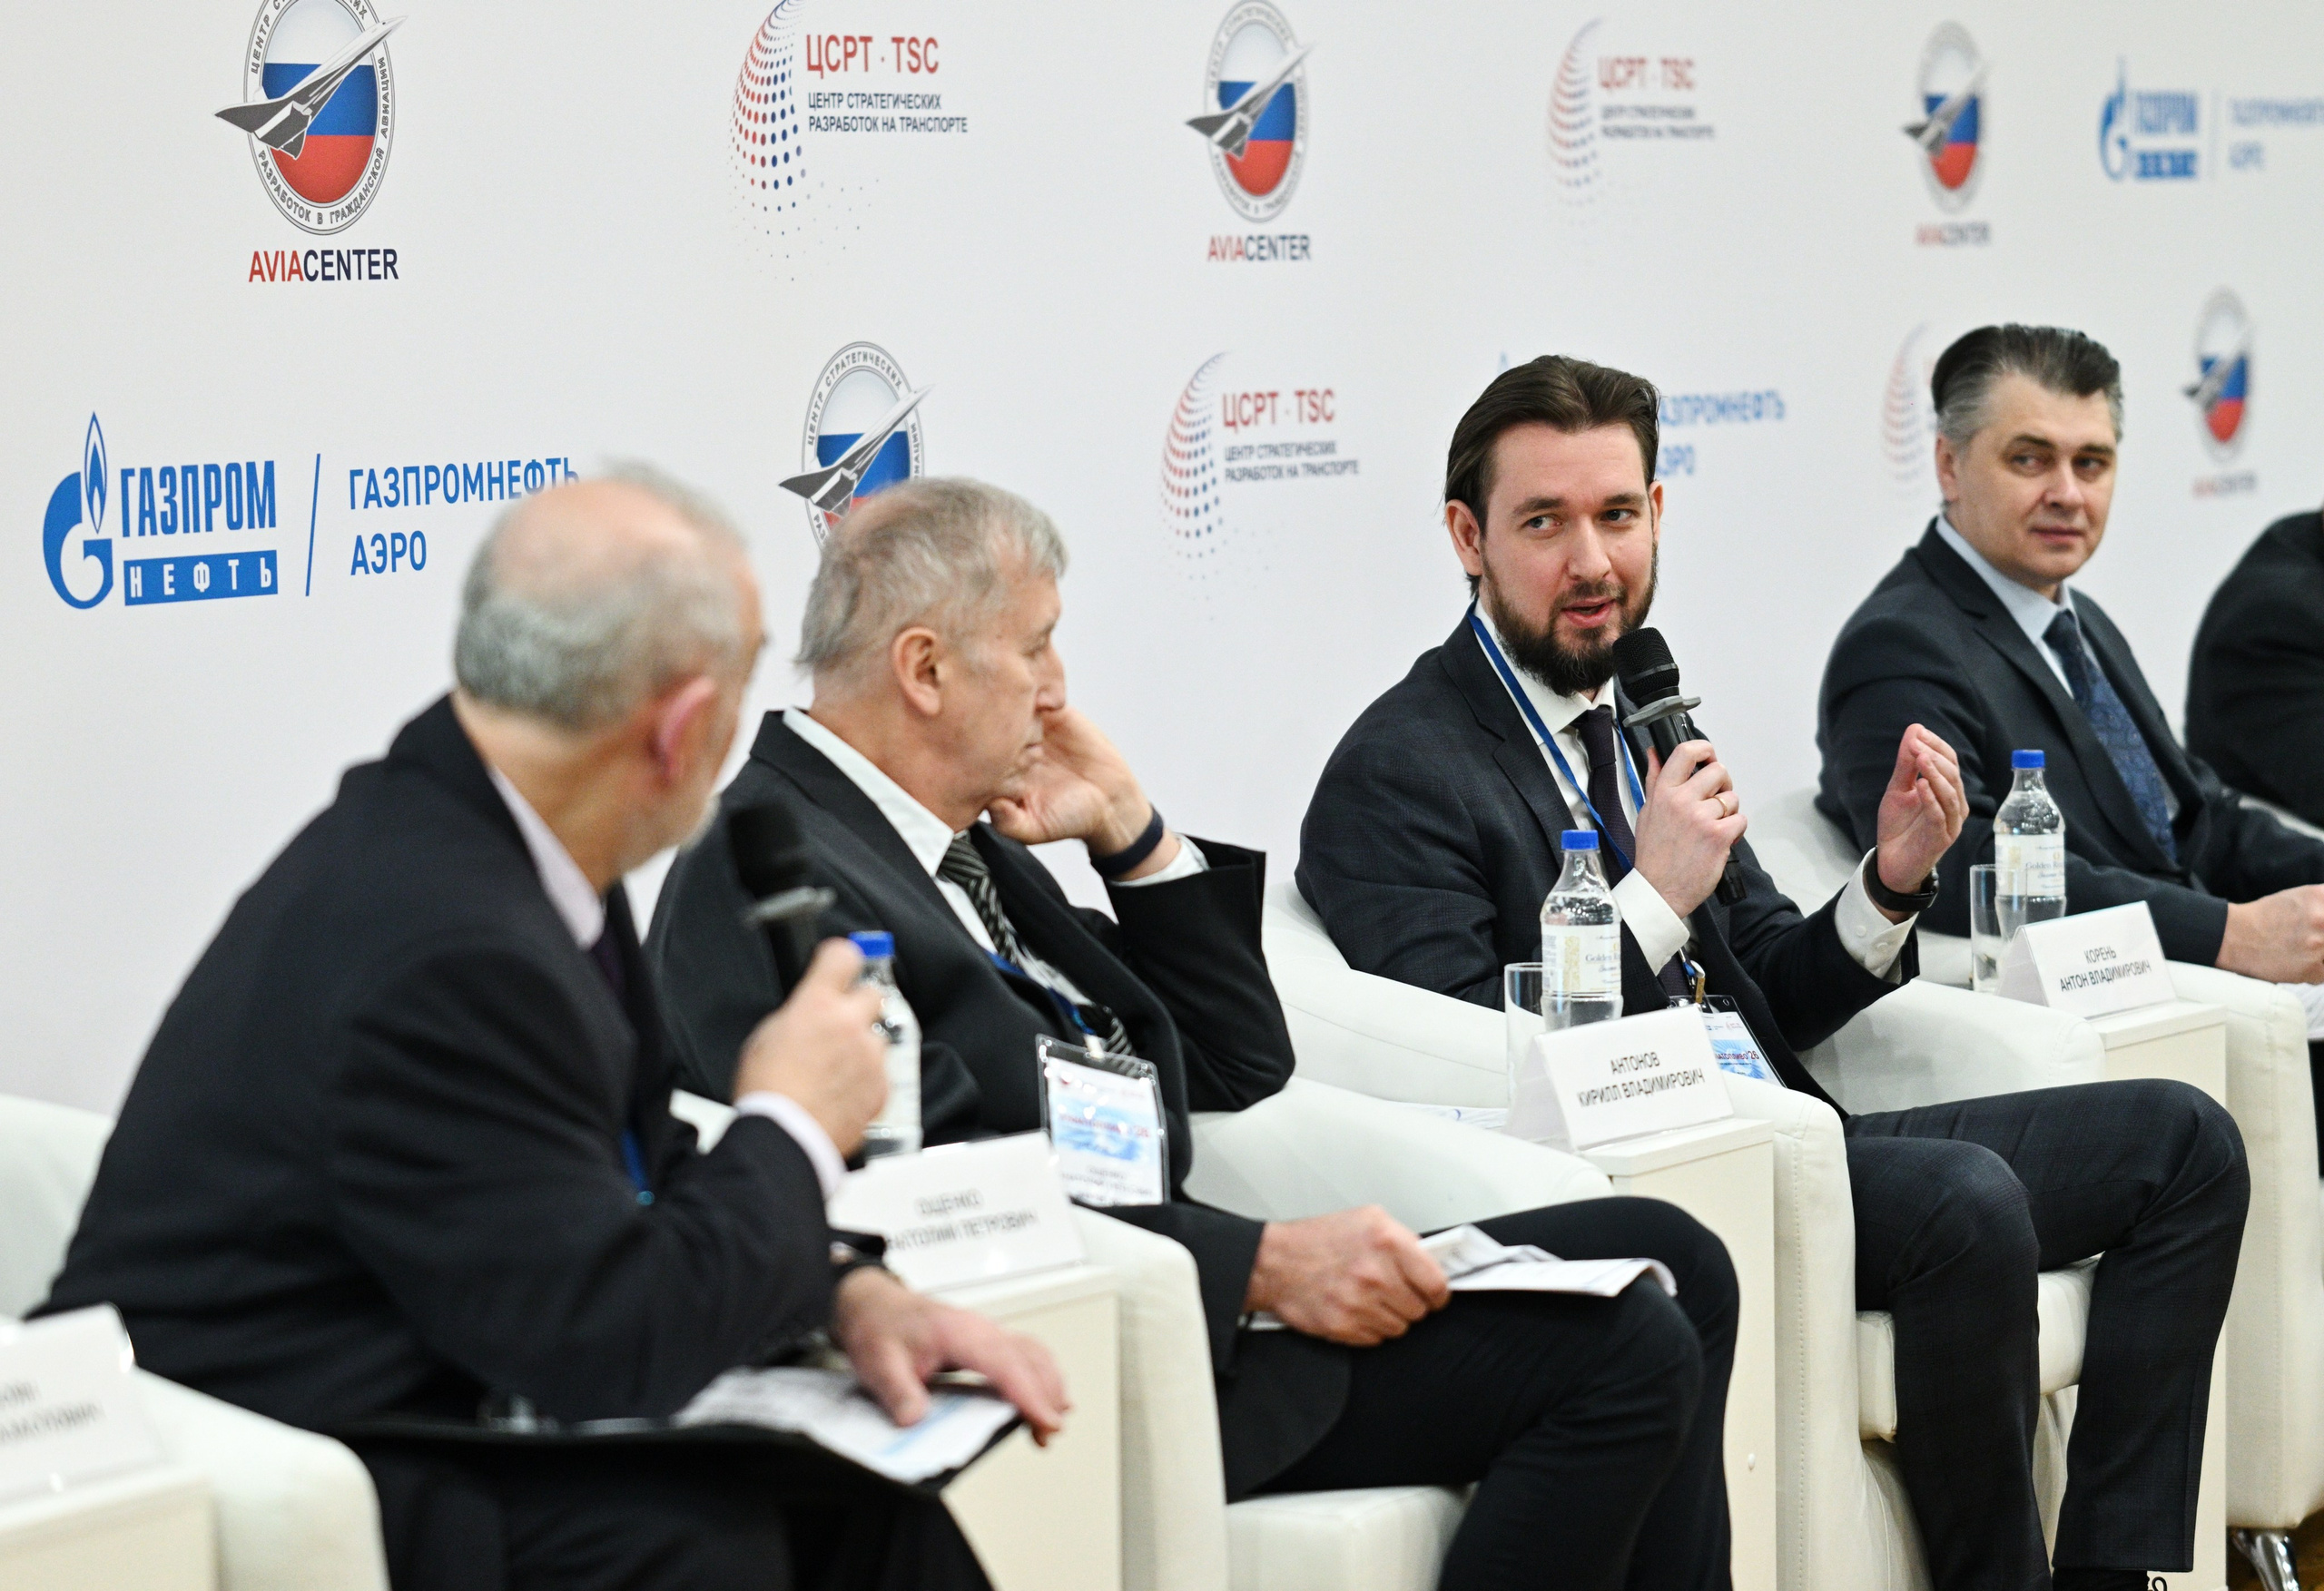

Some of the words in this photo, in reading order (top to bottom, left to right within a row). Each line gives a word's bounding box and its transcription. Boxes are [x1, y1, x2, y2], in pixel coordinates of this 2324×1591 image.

[251, 14, 271, 74] ЦЕНТР
[806, 34, 872, 79] ЦСРТ
[891, 36, 940, 74] TSC
[808, 92, 844, 111] ЦЕНТР
[847, 93, 941, 110] СТРАТЕГИЧЕСКИХ
[258, 150, 311, 222] РАЗРАБОТОК
[317, 211, 323, 225] В
[330, 147, 385, 224] ГРАЖДАНСКОЙ
[378, 56, 390, 138] АВИАЦИИ
[809, 115, 879, 133] РАЗРАБОТОК
[881, 116, 897, 133] НА
[899, 116, 968, 133] ТРАНСПОРТЕ
[249, 248, 399, 283] AVIACENTER
[1207, 234, 1312, 262] AVIACENTER
[807, 390, 823, 446] ЦЕНТР
[824, 350, 901, 390] СТРАТЕГИЧЕСКИХ
[1222, 391, 1279, 435] ЦСРТ
[1294, 388, 1335, 424] TSC
[120, 459, 277, 538] ГАЗПРОМ
[350, 530, 427, 575] АЭРО
[129, 556, 272, 599] НЕФТЬ
[2060, 971, 2089, 992] АНТОН
[2089, 959, 2152, 987] ВЛАДИМИРОВИЧ
[2084, 945, 2117, 964] КОРЕНЬ
[1610, 1051, 1660, 1075] АНТОНОВ
[1578, 1084, 1621, 1108] КИРИЛЛ
[1621, 1067, 1706, 1099] ВЛАДИМИРОВИЧ
